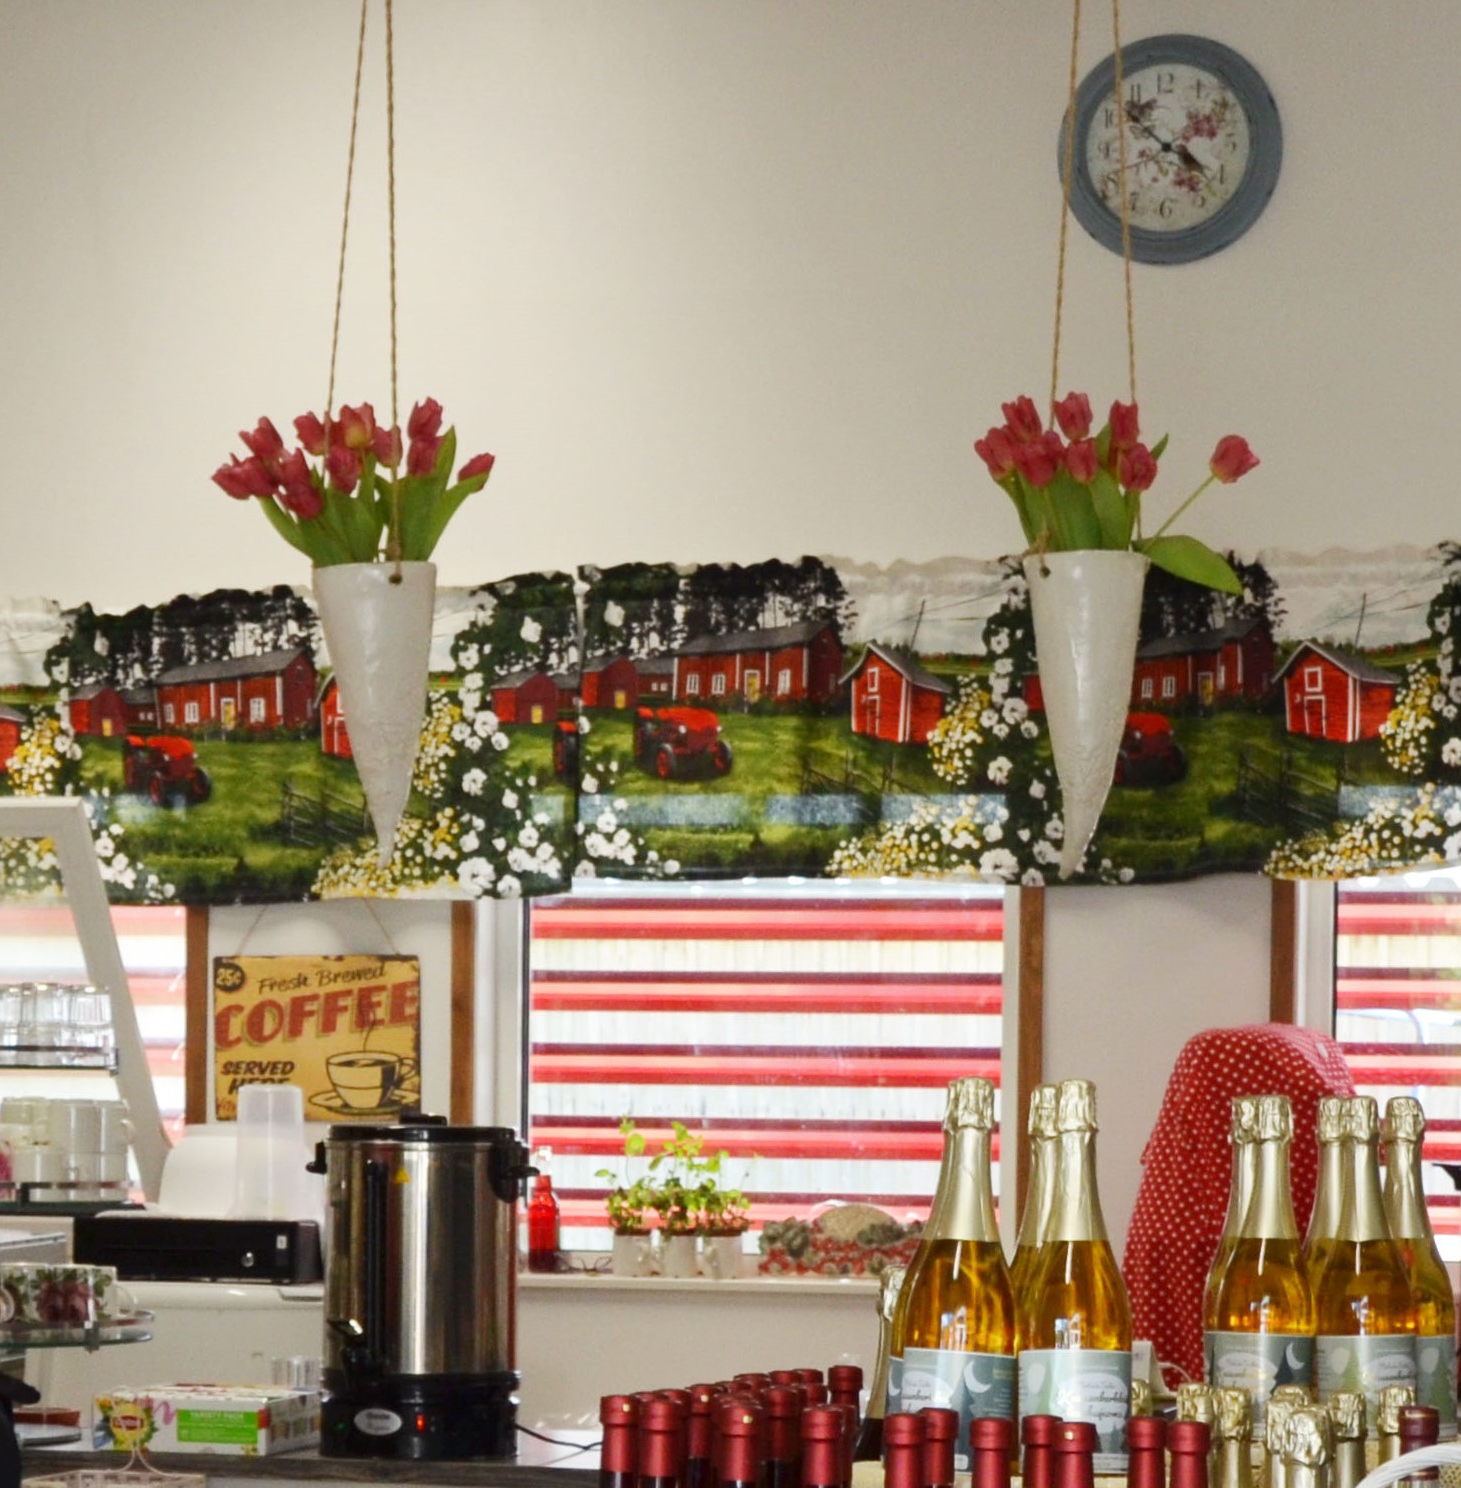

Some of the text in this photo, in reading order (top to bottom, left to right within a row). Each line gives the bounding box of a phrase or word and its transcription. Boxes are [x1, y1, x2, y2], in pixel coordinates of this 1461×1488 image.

[258, 964, 387, 995] Fresh Brewed
[214, 980, 420, 1050] COFFEE
[220, 1060, 295, 1076] SERVED
